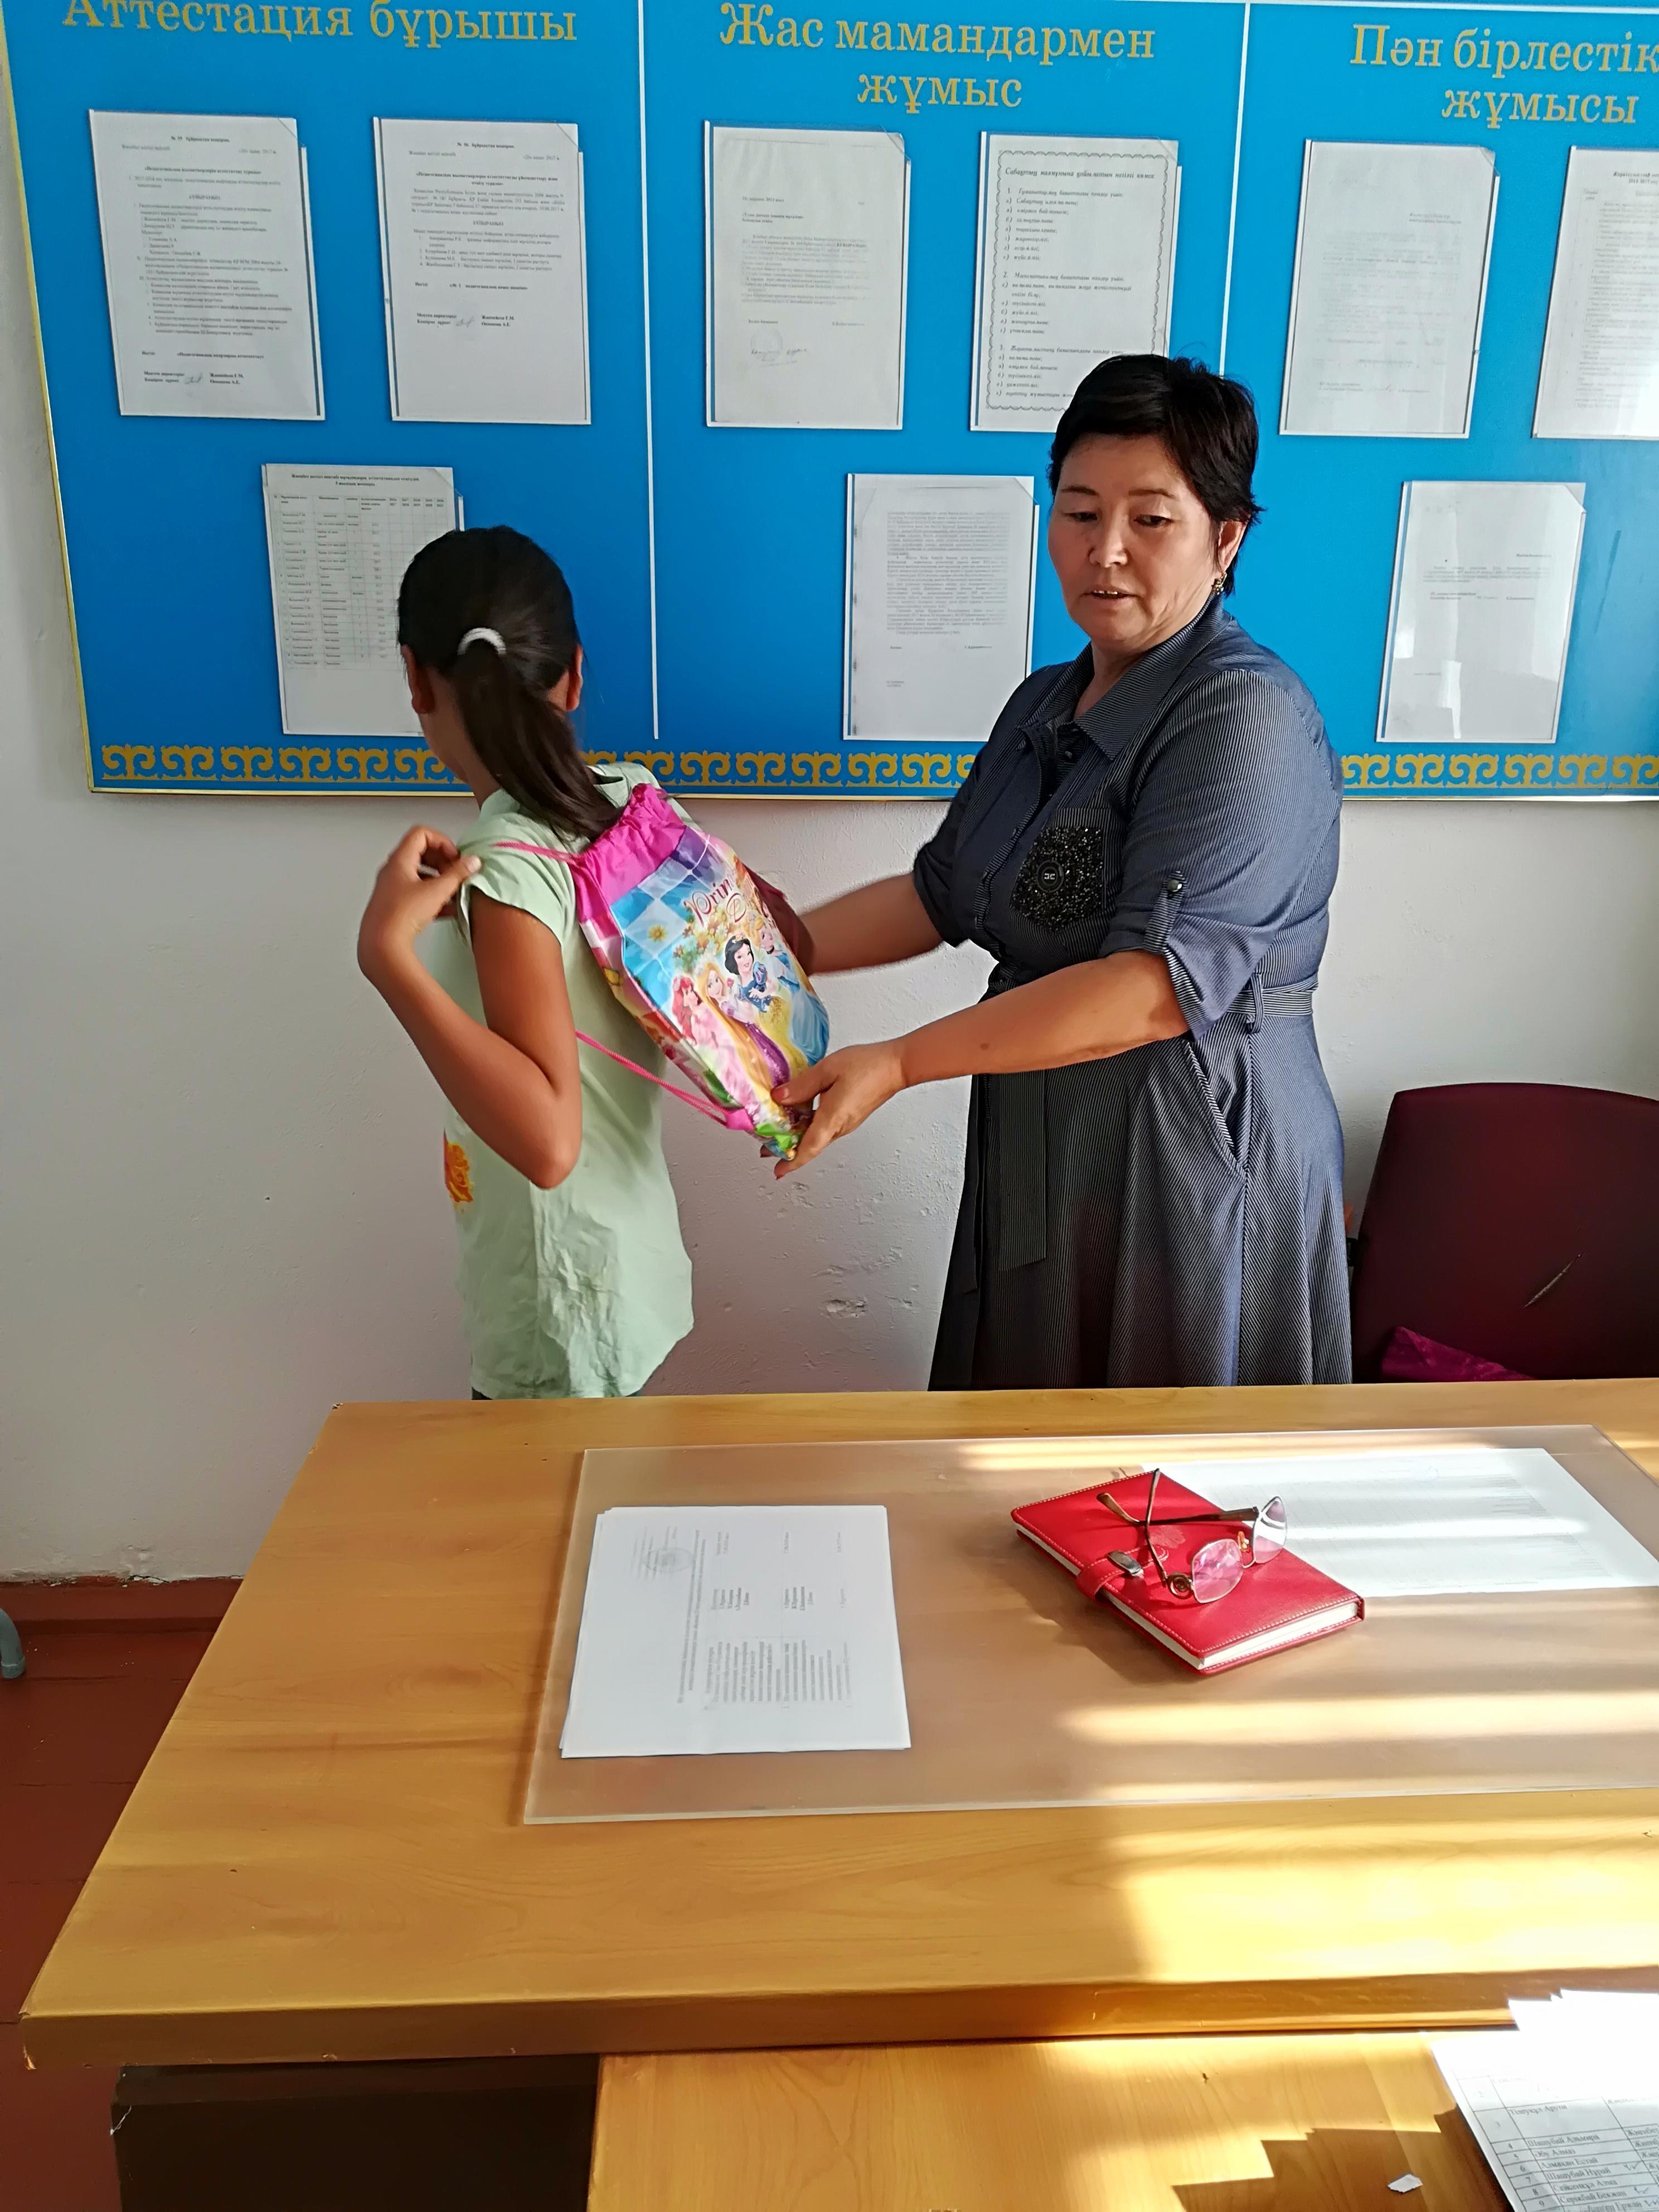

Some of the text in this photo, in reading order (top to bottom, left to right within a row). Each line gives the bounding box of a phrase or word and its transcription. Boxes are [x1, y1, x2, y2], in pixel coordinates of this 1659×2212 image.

[62, 0, 577, 48] Аттестация бұрышы
[720, 3, 1155, 66] Жас мамандармен
[1350, 24, 1659, 78] Пән бірлестік
[857, 74, 1022, 114] жұмыс
[1442, 90, 1639, 129] жұмысы
